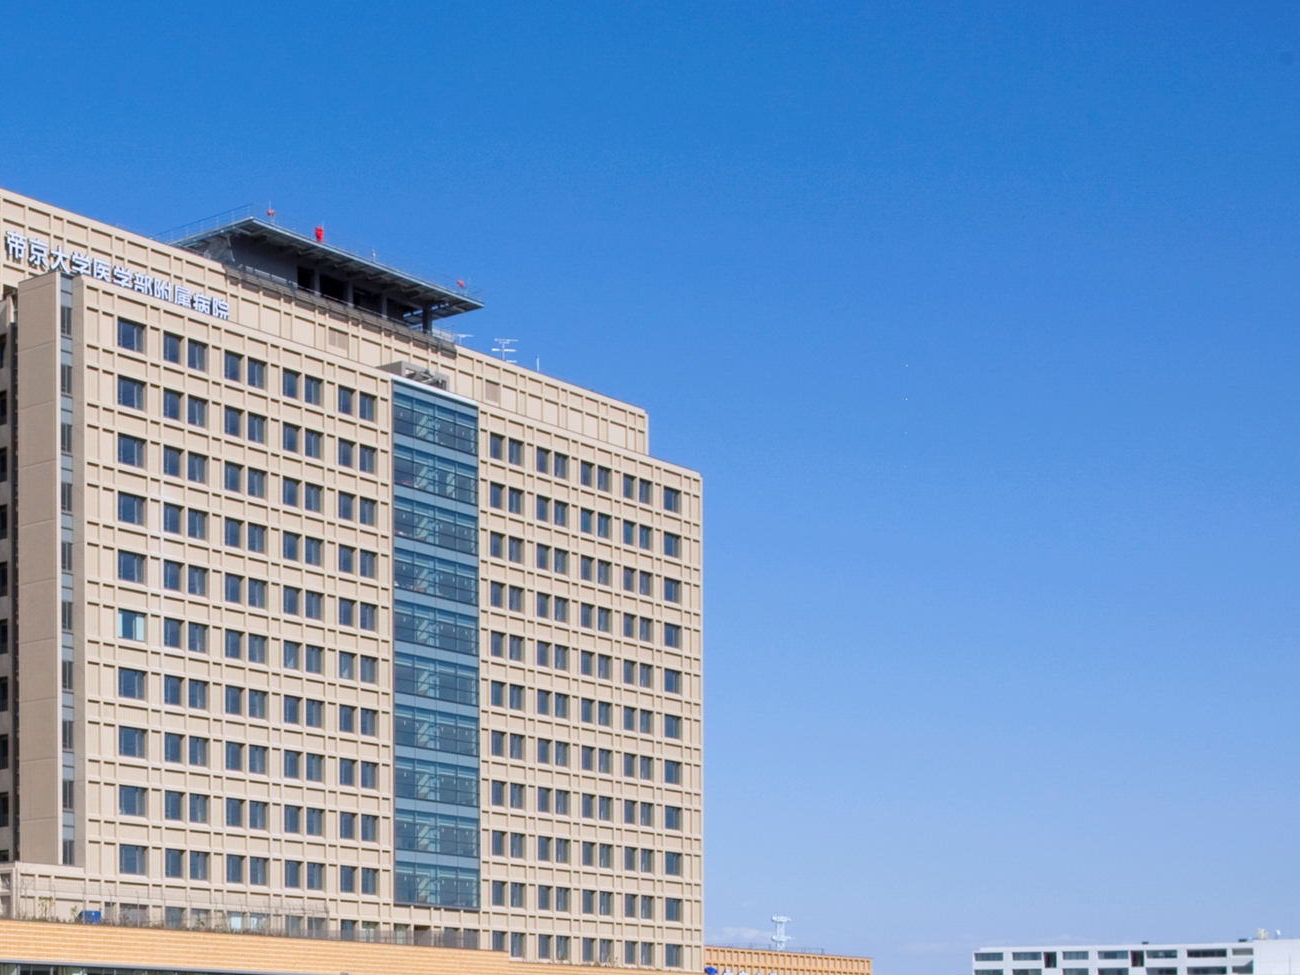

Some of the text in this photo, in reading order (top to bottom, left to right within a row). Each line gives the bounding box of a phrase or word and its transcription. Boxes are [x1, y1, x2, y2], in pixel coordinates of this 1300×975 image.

[6, 231, 229, 319] 帝京大学医学部附属病院
